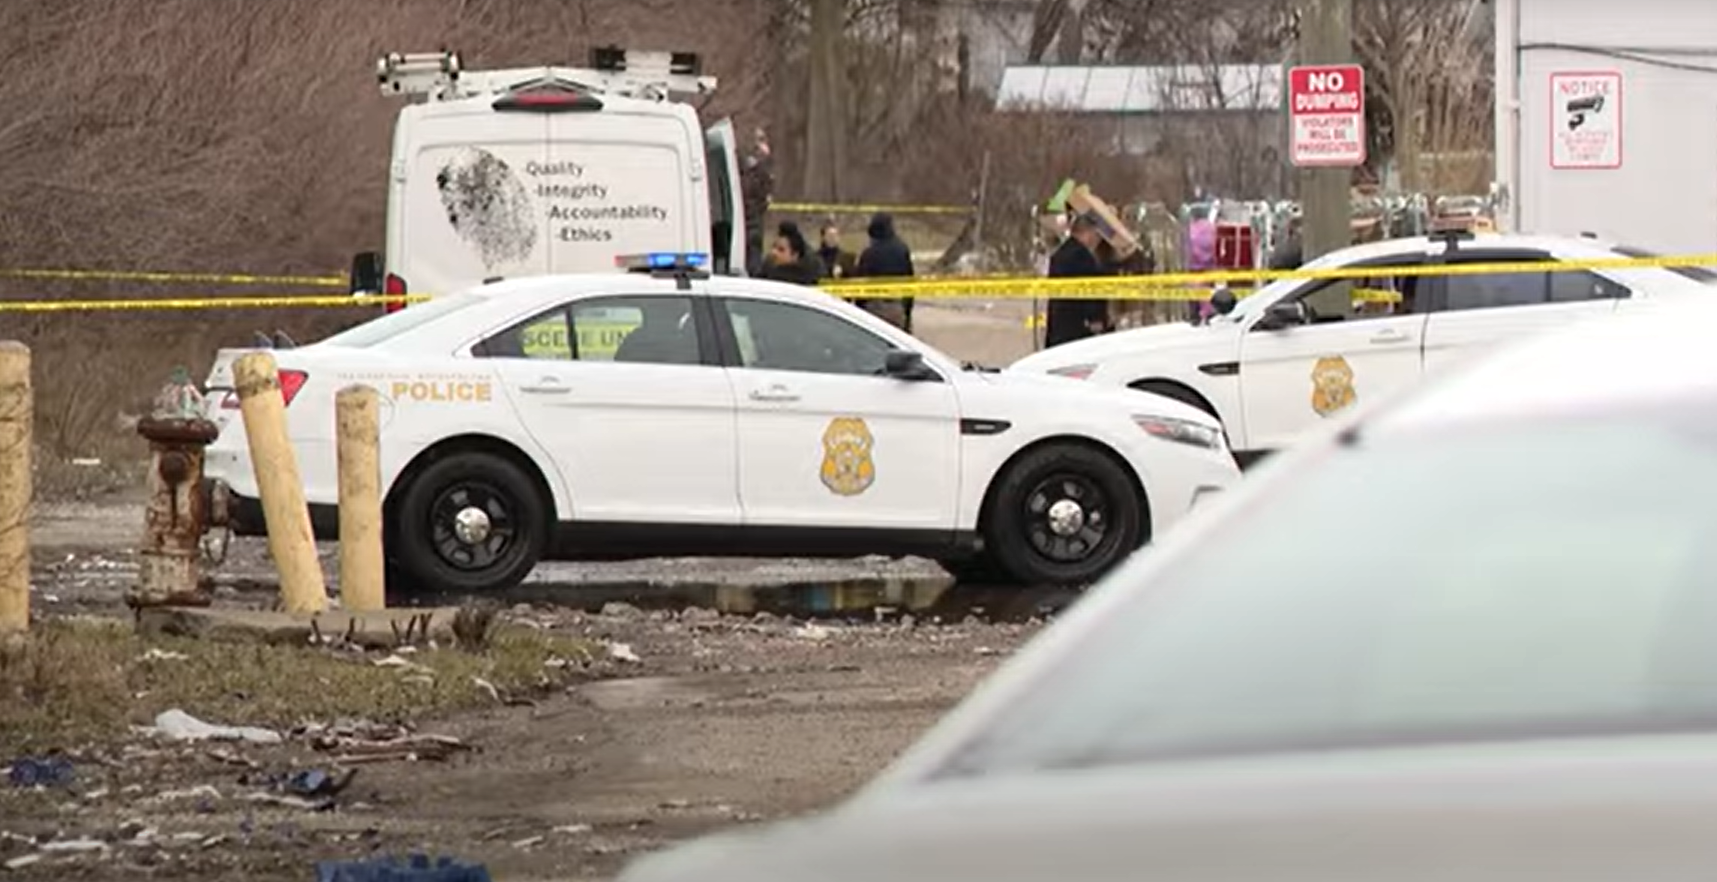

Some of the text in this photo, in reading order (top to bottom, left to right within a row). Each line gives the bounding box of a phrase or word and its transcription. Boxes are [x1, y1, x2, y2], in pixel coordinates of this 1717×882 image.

[1308, 72, 1345, 92] NO
[1560, 80, 1609, 94] NOTICE
[1295, 91, 1359, 111] DUMPING
[1301, 117, 1354, 128] VIOLATORS
[1309, 129, 1347, 139] WILL BE
[1297, 142, 1358, 153] PROSECUTED
[391, 381, 492, 402] POLICE
